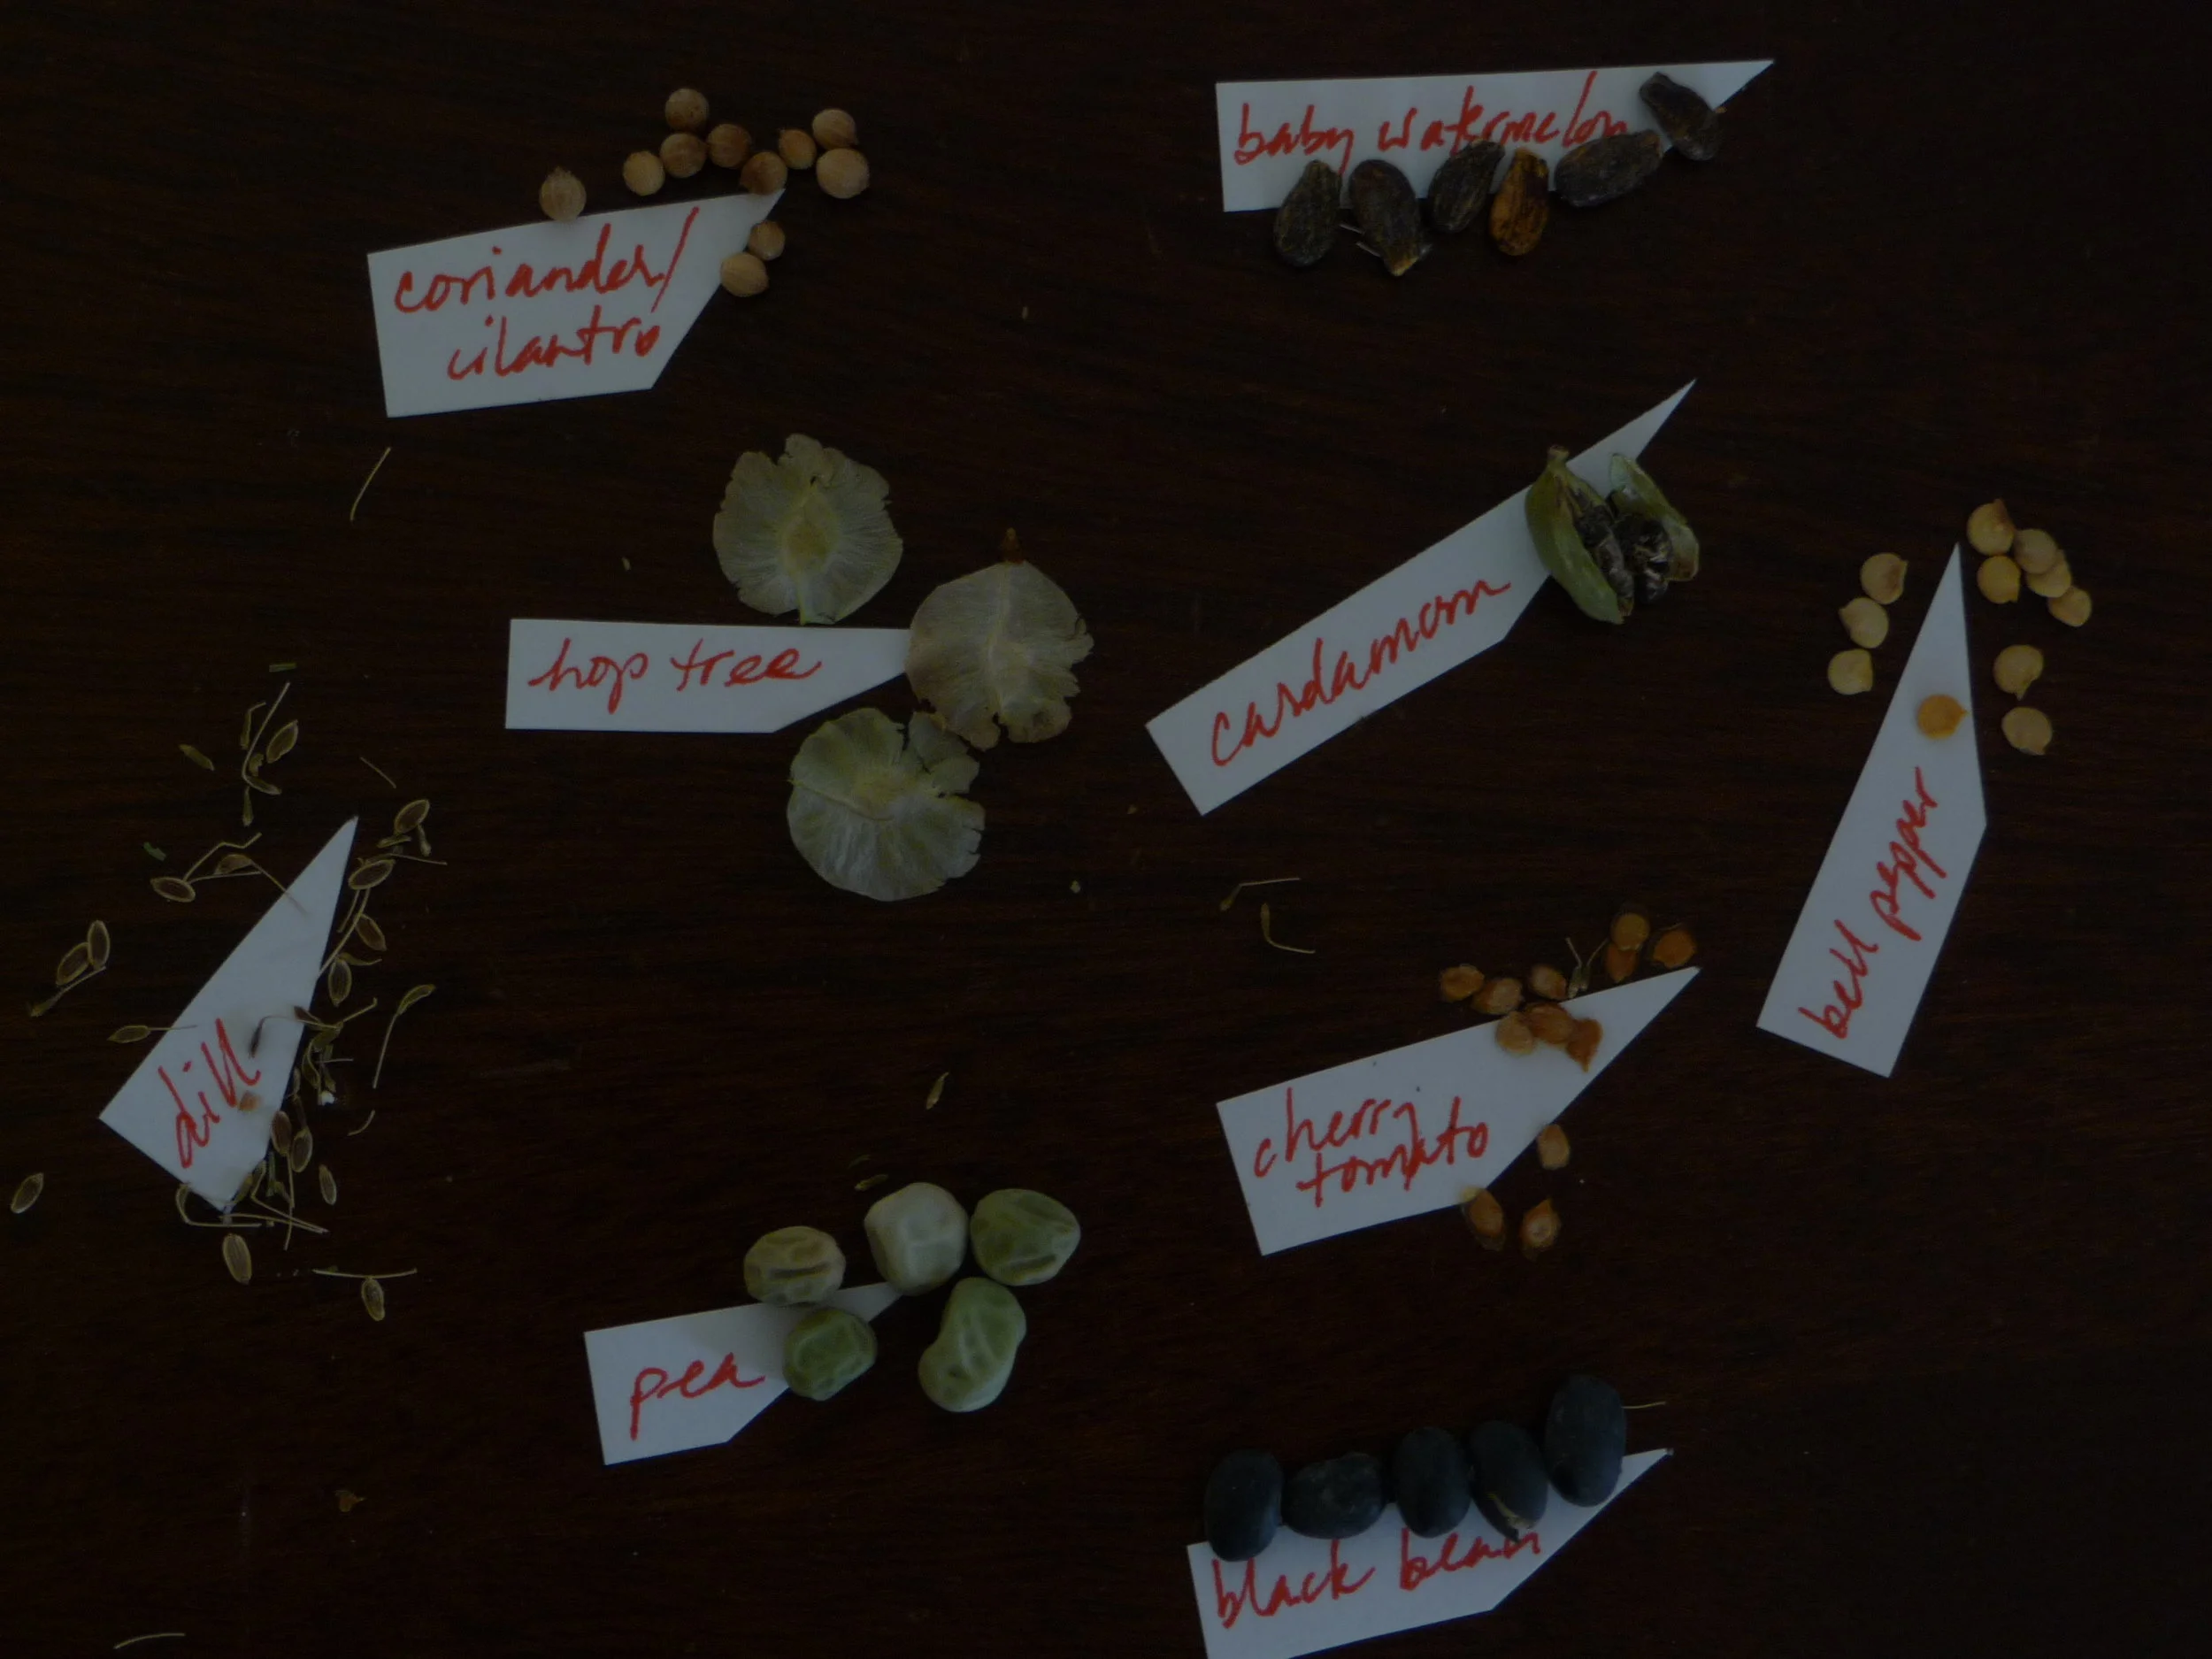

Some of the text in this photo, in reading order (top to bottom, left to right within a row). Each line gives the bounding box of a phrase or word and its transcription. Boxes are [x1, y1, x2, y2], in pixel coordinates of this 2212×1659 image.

[1234, 71, 1629, 176] baby watermelon
[448, 304, 661, 380] cilantro
[528, 637, 823, 715] hop tree
[1211, 580, 1511, 767] cardamom
[1798, 766, 1947, 1040] bell pepper
[157, 1018, 262, 1169] dill
[1254, 1087, 1420, 1191] cherry
[1295, 1096, 1489, 1208] tomato
[629, 1351, 766, 1441] pea
[1212, 1539, 1376, 1630] black
